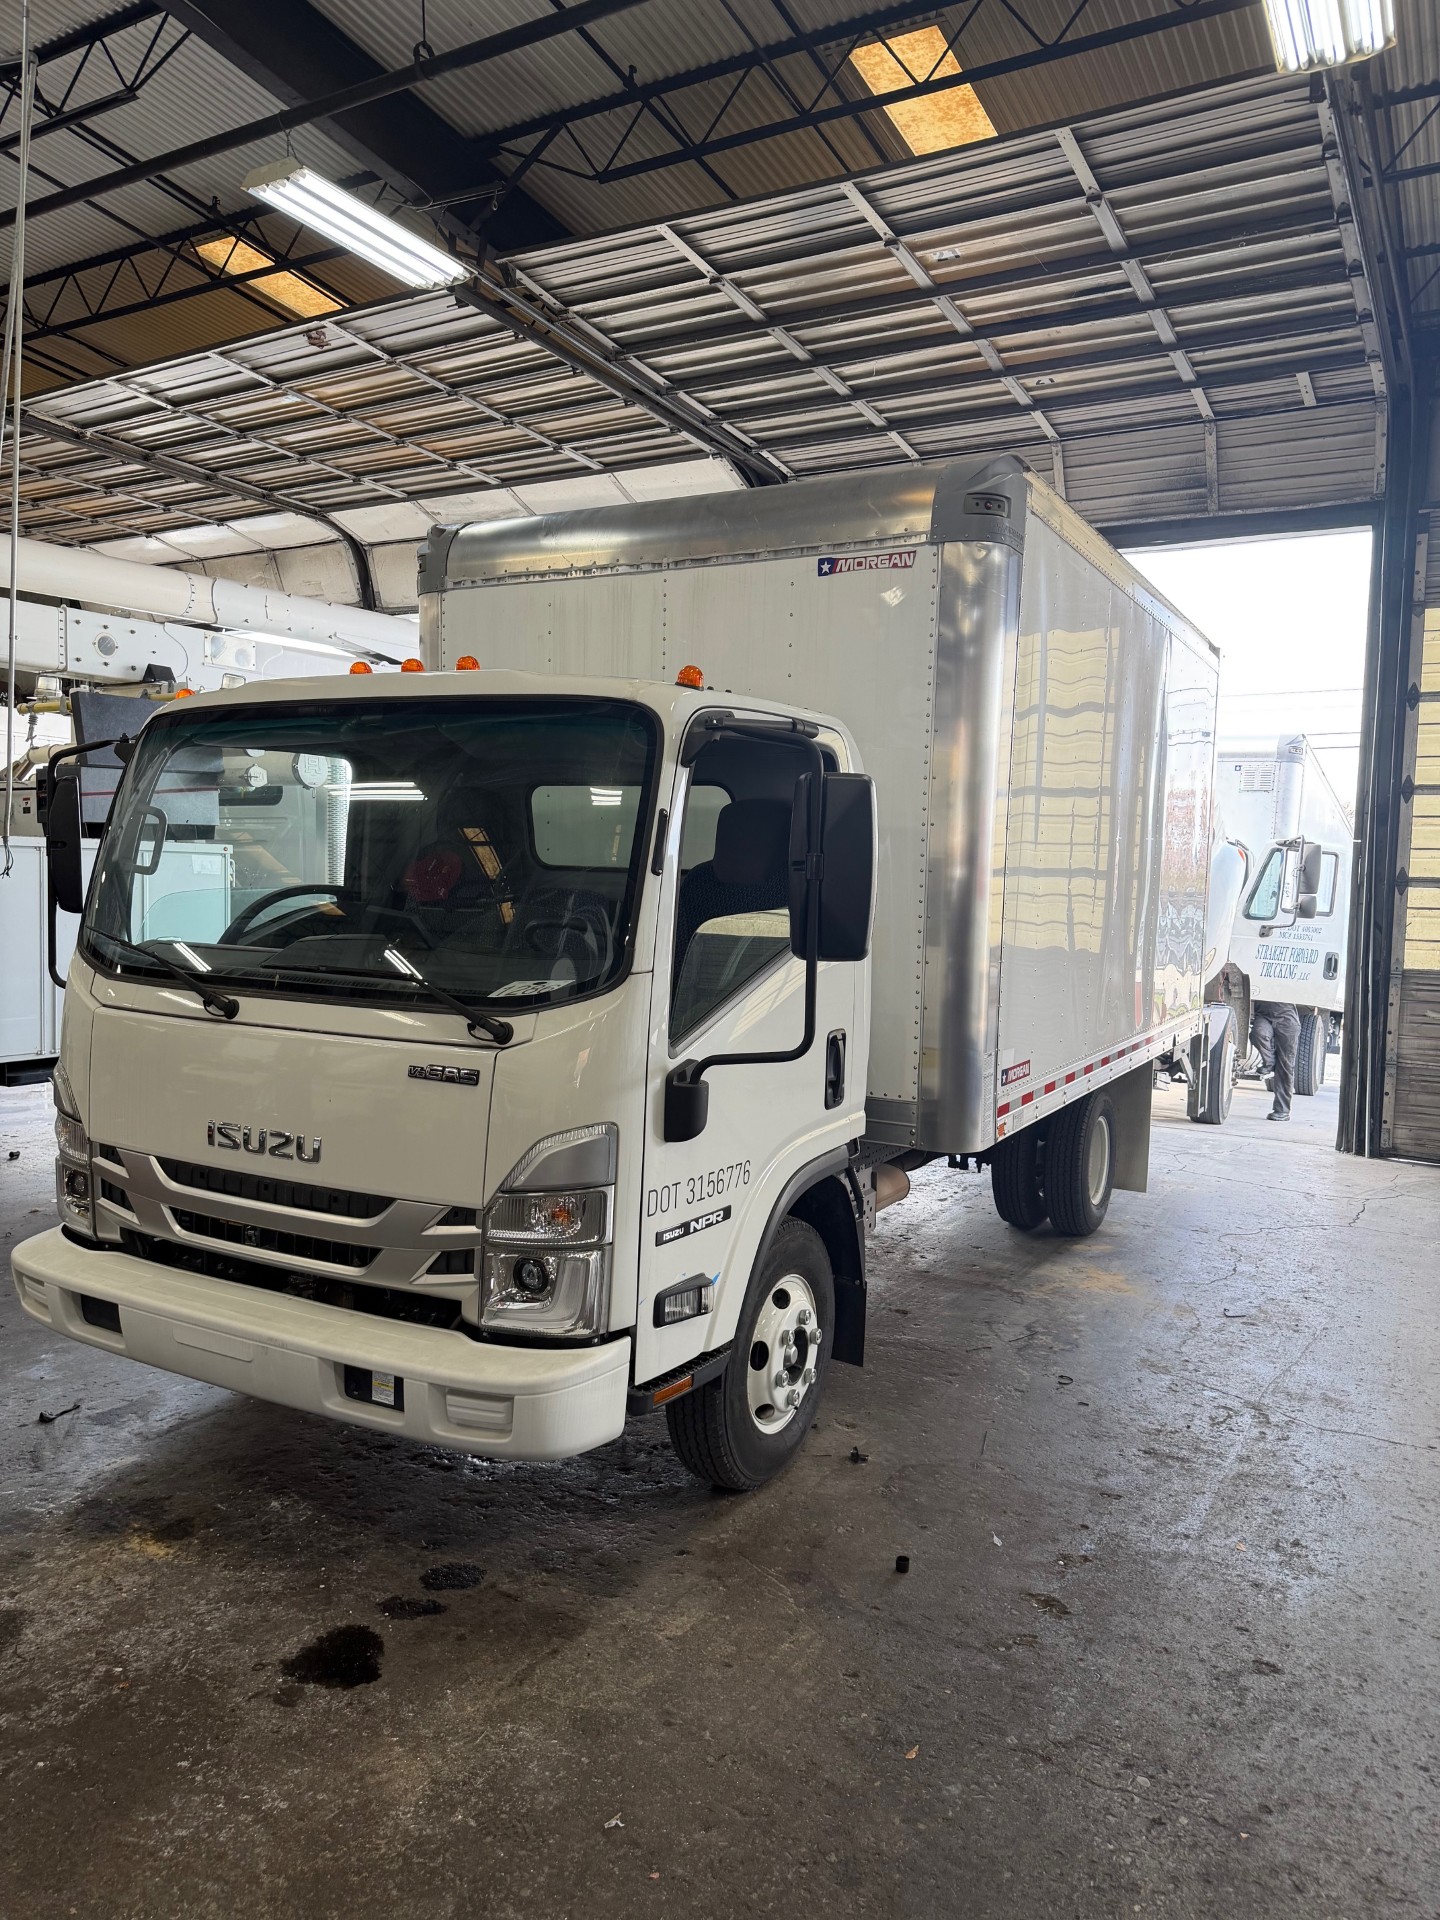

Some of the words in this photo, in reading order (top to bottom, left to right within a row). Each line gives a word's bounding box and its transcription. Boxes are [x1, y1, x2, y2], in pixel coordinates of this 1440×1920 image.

[835, 552, 914, 573] MORGAN
[1255, 944, 1290, 962] STRAIGHT
[1289, 947, 1319, 964] FORWARD
[1260, 962, 1298, 980] TRUCKING
[1007, 1062, 1030, 1083] MORGAN
[207, 1119, 322, 1163] ISUZU
[647, 1181, 682, 1217] DOT
[686, 1159, 751, 1205] 3156776
[663, 1227, 685, 1241] ISUZU
[689, 1210, 724, 1233] NPR
